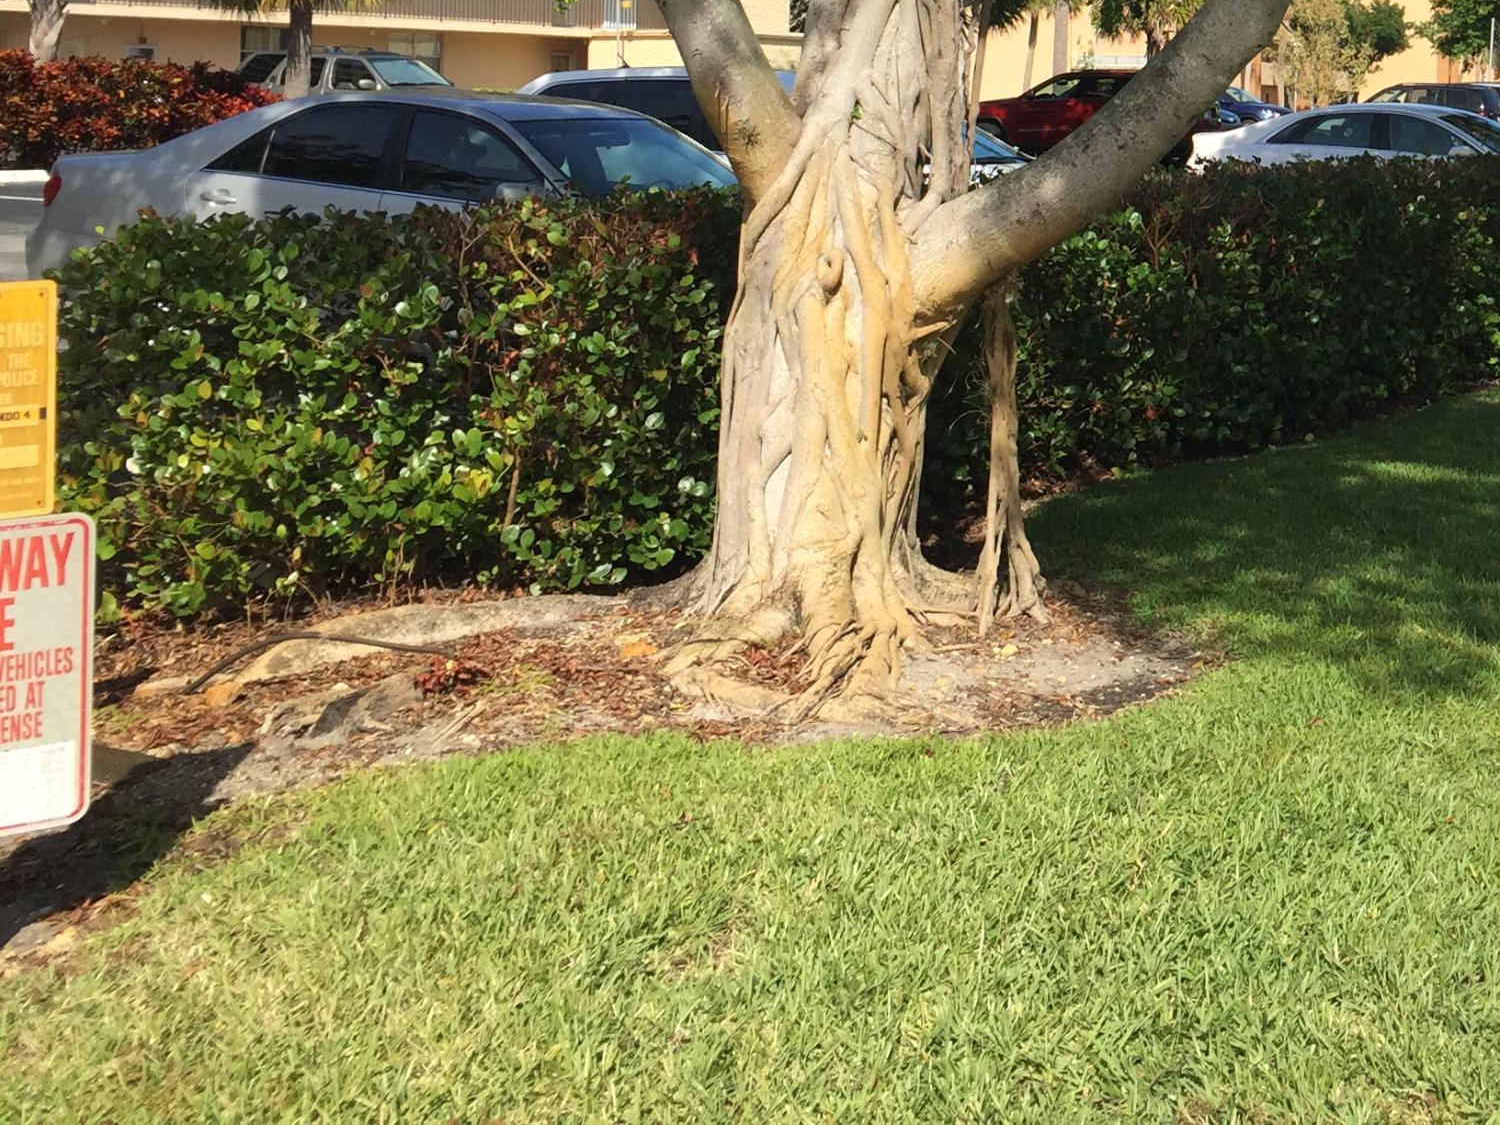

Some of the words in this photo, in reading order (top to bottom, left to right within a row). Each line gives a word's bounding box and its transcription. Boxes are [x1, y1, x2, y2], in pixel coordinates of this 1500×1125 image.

[6, 353, 31, 370] THE
[0, 369, 39, 388] OLICE
[0, 531, 75, 592] WAY
[25, 681, 45, 709] AT
